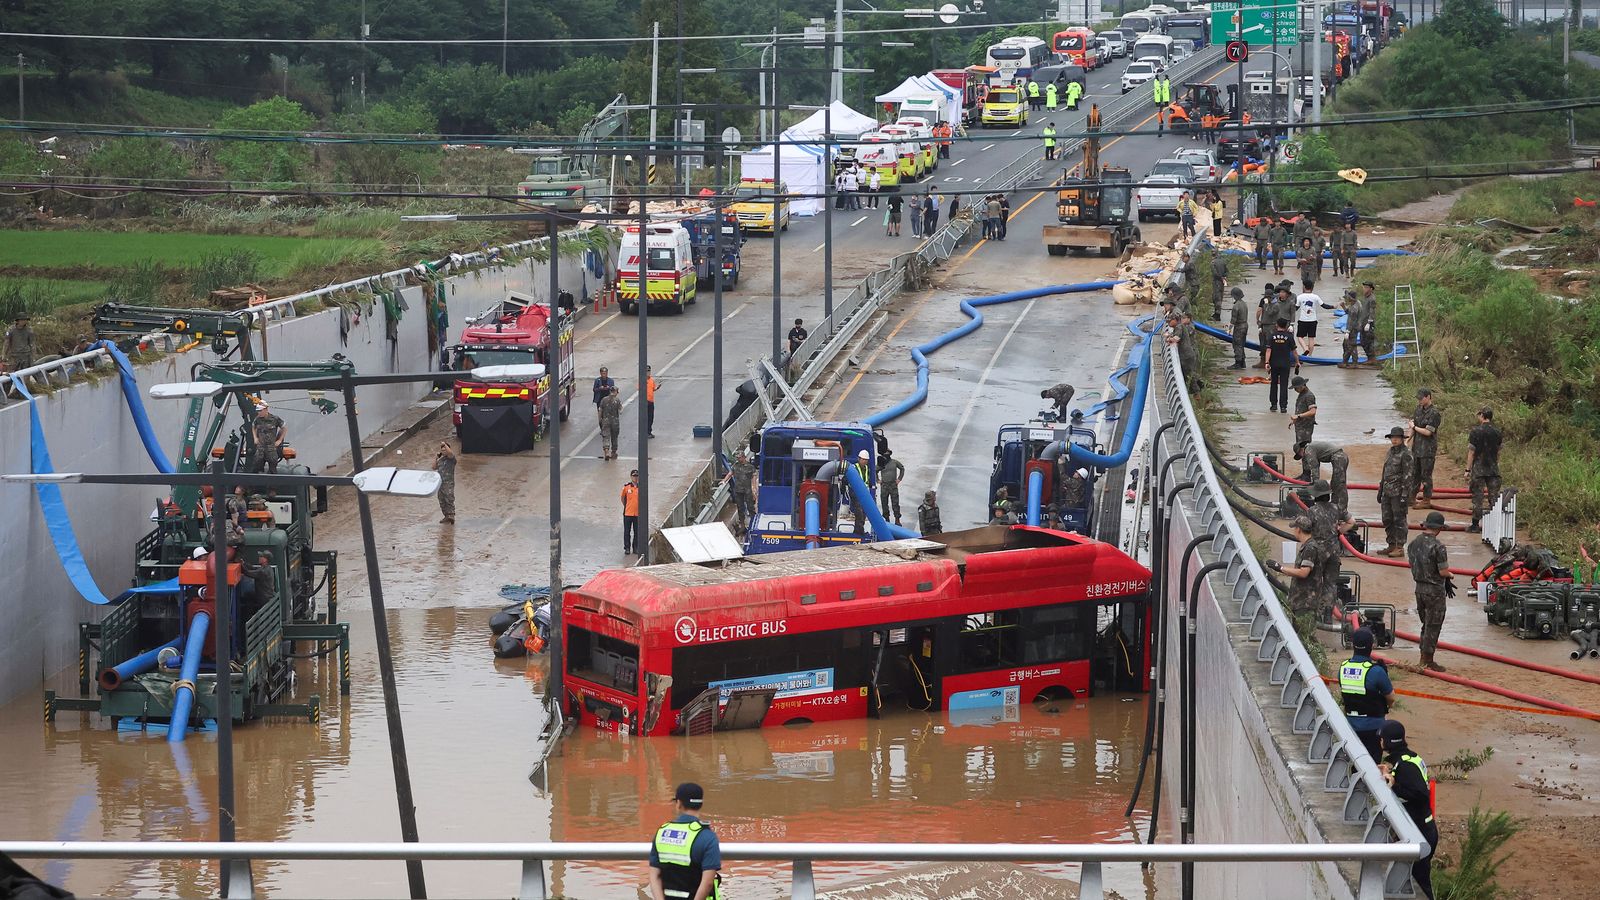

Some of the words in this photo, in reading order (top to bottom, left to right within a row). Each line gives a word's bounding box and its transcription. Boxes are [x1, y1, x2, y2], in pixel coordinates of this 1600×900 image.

[1061, 38, 1077, 46] 119
[863, 152, 880, 160] 119
[1085, 580, 1146, 598] 친환경전기버스
[699, 623, 757, 642] ELECTRIC
[761, 619, 787, 635] BUS
[1009, 669, 1041, 682] 급행버스
[812, 694, 847, 706] KTX오송역
